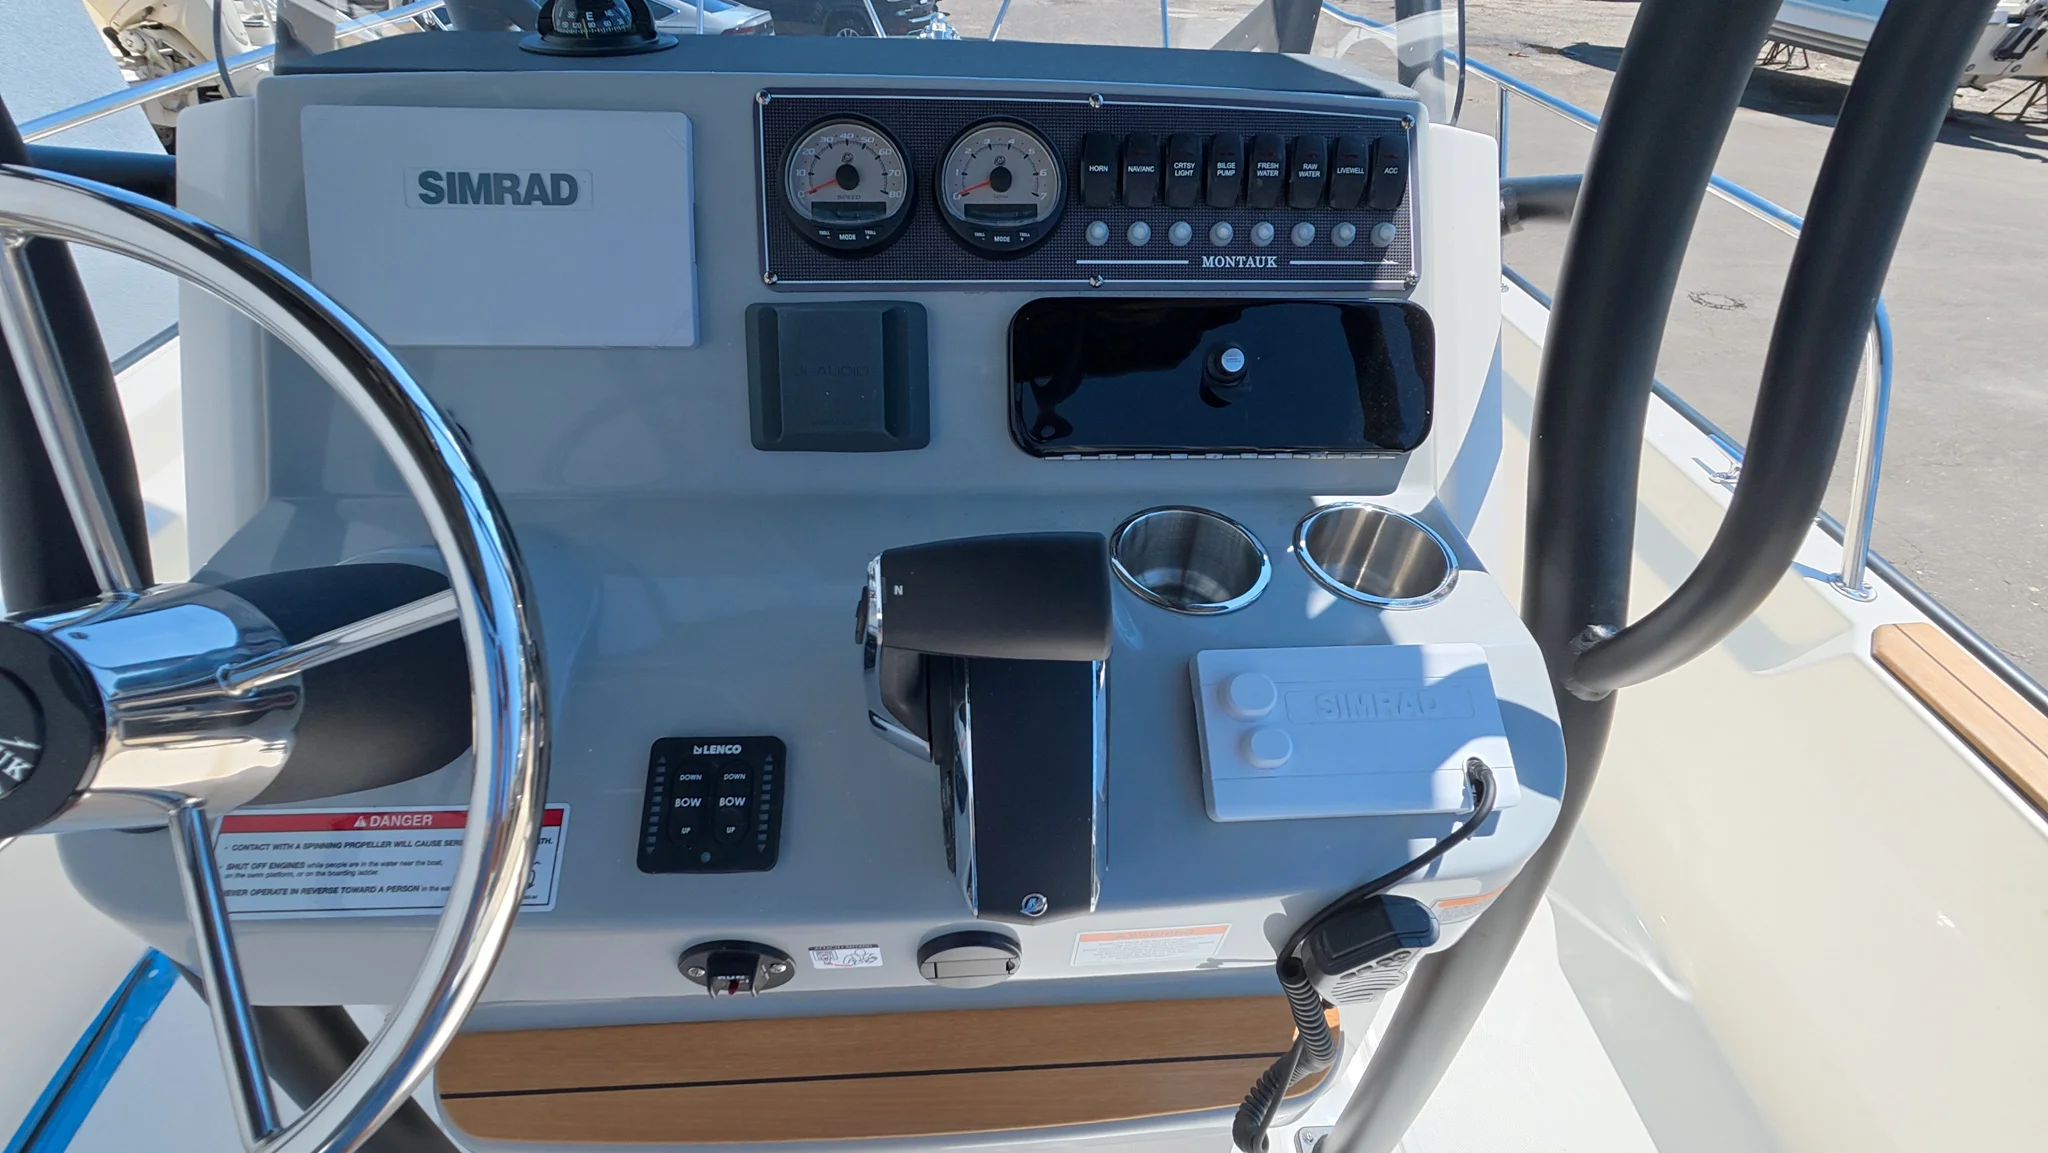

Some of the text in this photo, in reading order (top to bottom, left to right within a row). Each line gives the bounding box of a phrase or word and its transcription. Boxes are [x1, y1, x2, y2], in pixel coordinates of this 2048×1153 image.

[586, 12, 594, 20] E
[418, 170, 578, 206] SIMRAD
[1040, 192, 1047, 200] 7
[1202, 256, 1278, 268] MONTAUK
[816, 365, 870, 376] AUDIO
[894, 585, 903, 595] N
[1314, 690, 1438, 718] SIMRAD
[703, 744, 742, 754] LENCO
[675, 798, 702, 807] BOW
[720, 797, 746, 806] BOW
[370, 814, 432, 826] DANGER
[726, 826, 735, 834] UP
[303, 842, 342, 850] SPINNING
[394, 840, 412, 848] WILL
[226, 862, 250, 870] SHUT
[251, 862, 268, 870] OFF
[324, 862, 348, 870] people
[327, 870, 356, 878] boarding
[250, 888, 288, 896] OPERATE
[301, 886, 338, 894] REVERSE
[341, 886, 376, 894] TOWARD
